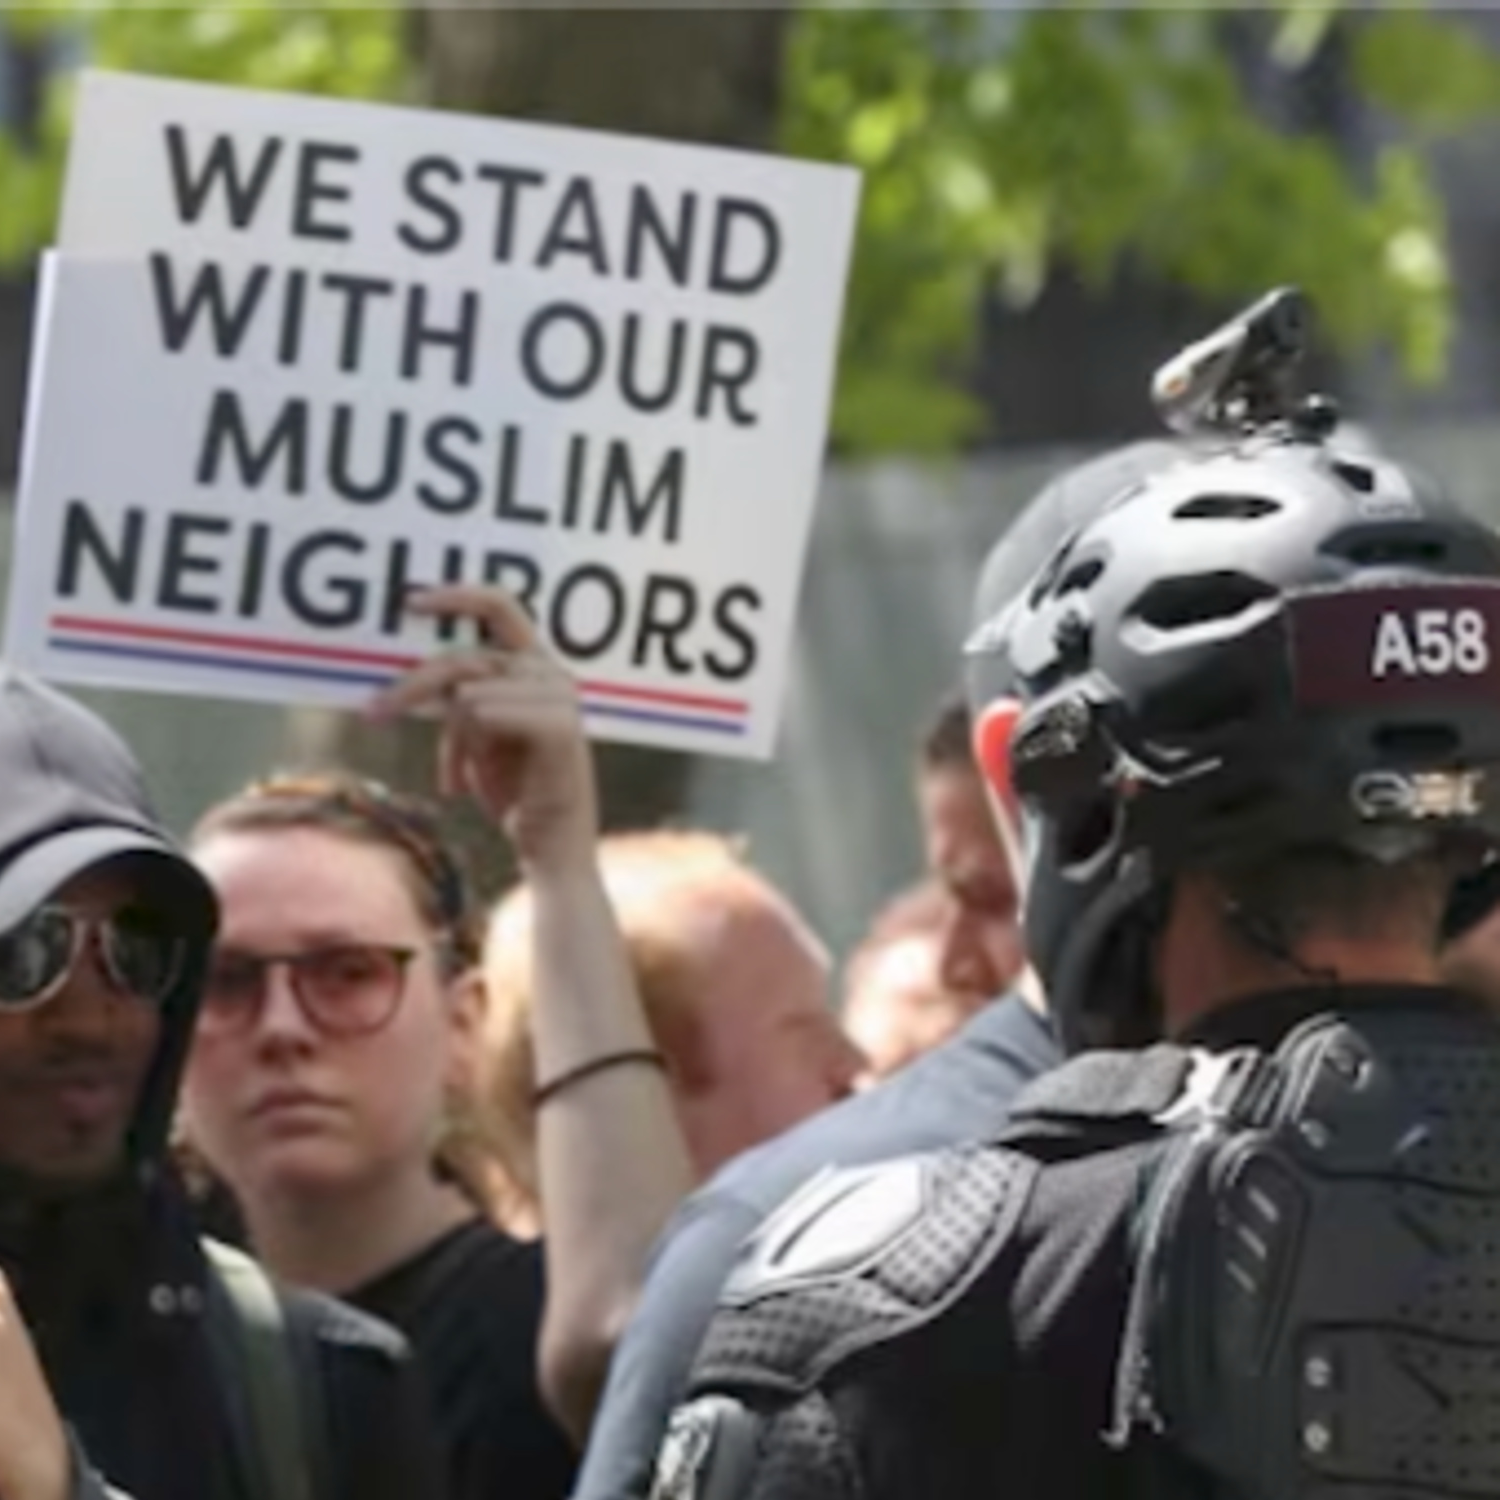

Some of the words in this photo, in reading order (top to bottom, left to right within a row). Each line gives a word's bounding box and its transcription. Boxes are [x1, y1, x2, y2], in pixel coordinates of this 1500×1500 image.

[165, 124, 360, 243] WE
[396, 155, 781, 296] STAND
[149, 252, 479, 387] WITH
[519, 301, 759, 427] OUR
[195, 388, 685, 543] MUSLIM
[1369, 607, 1491, 679] A58
